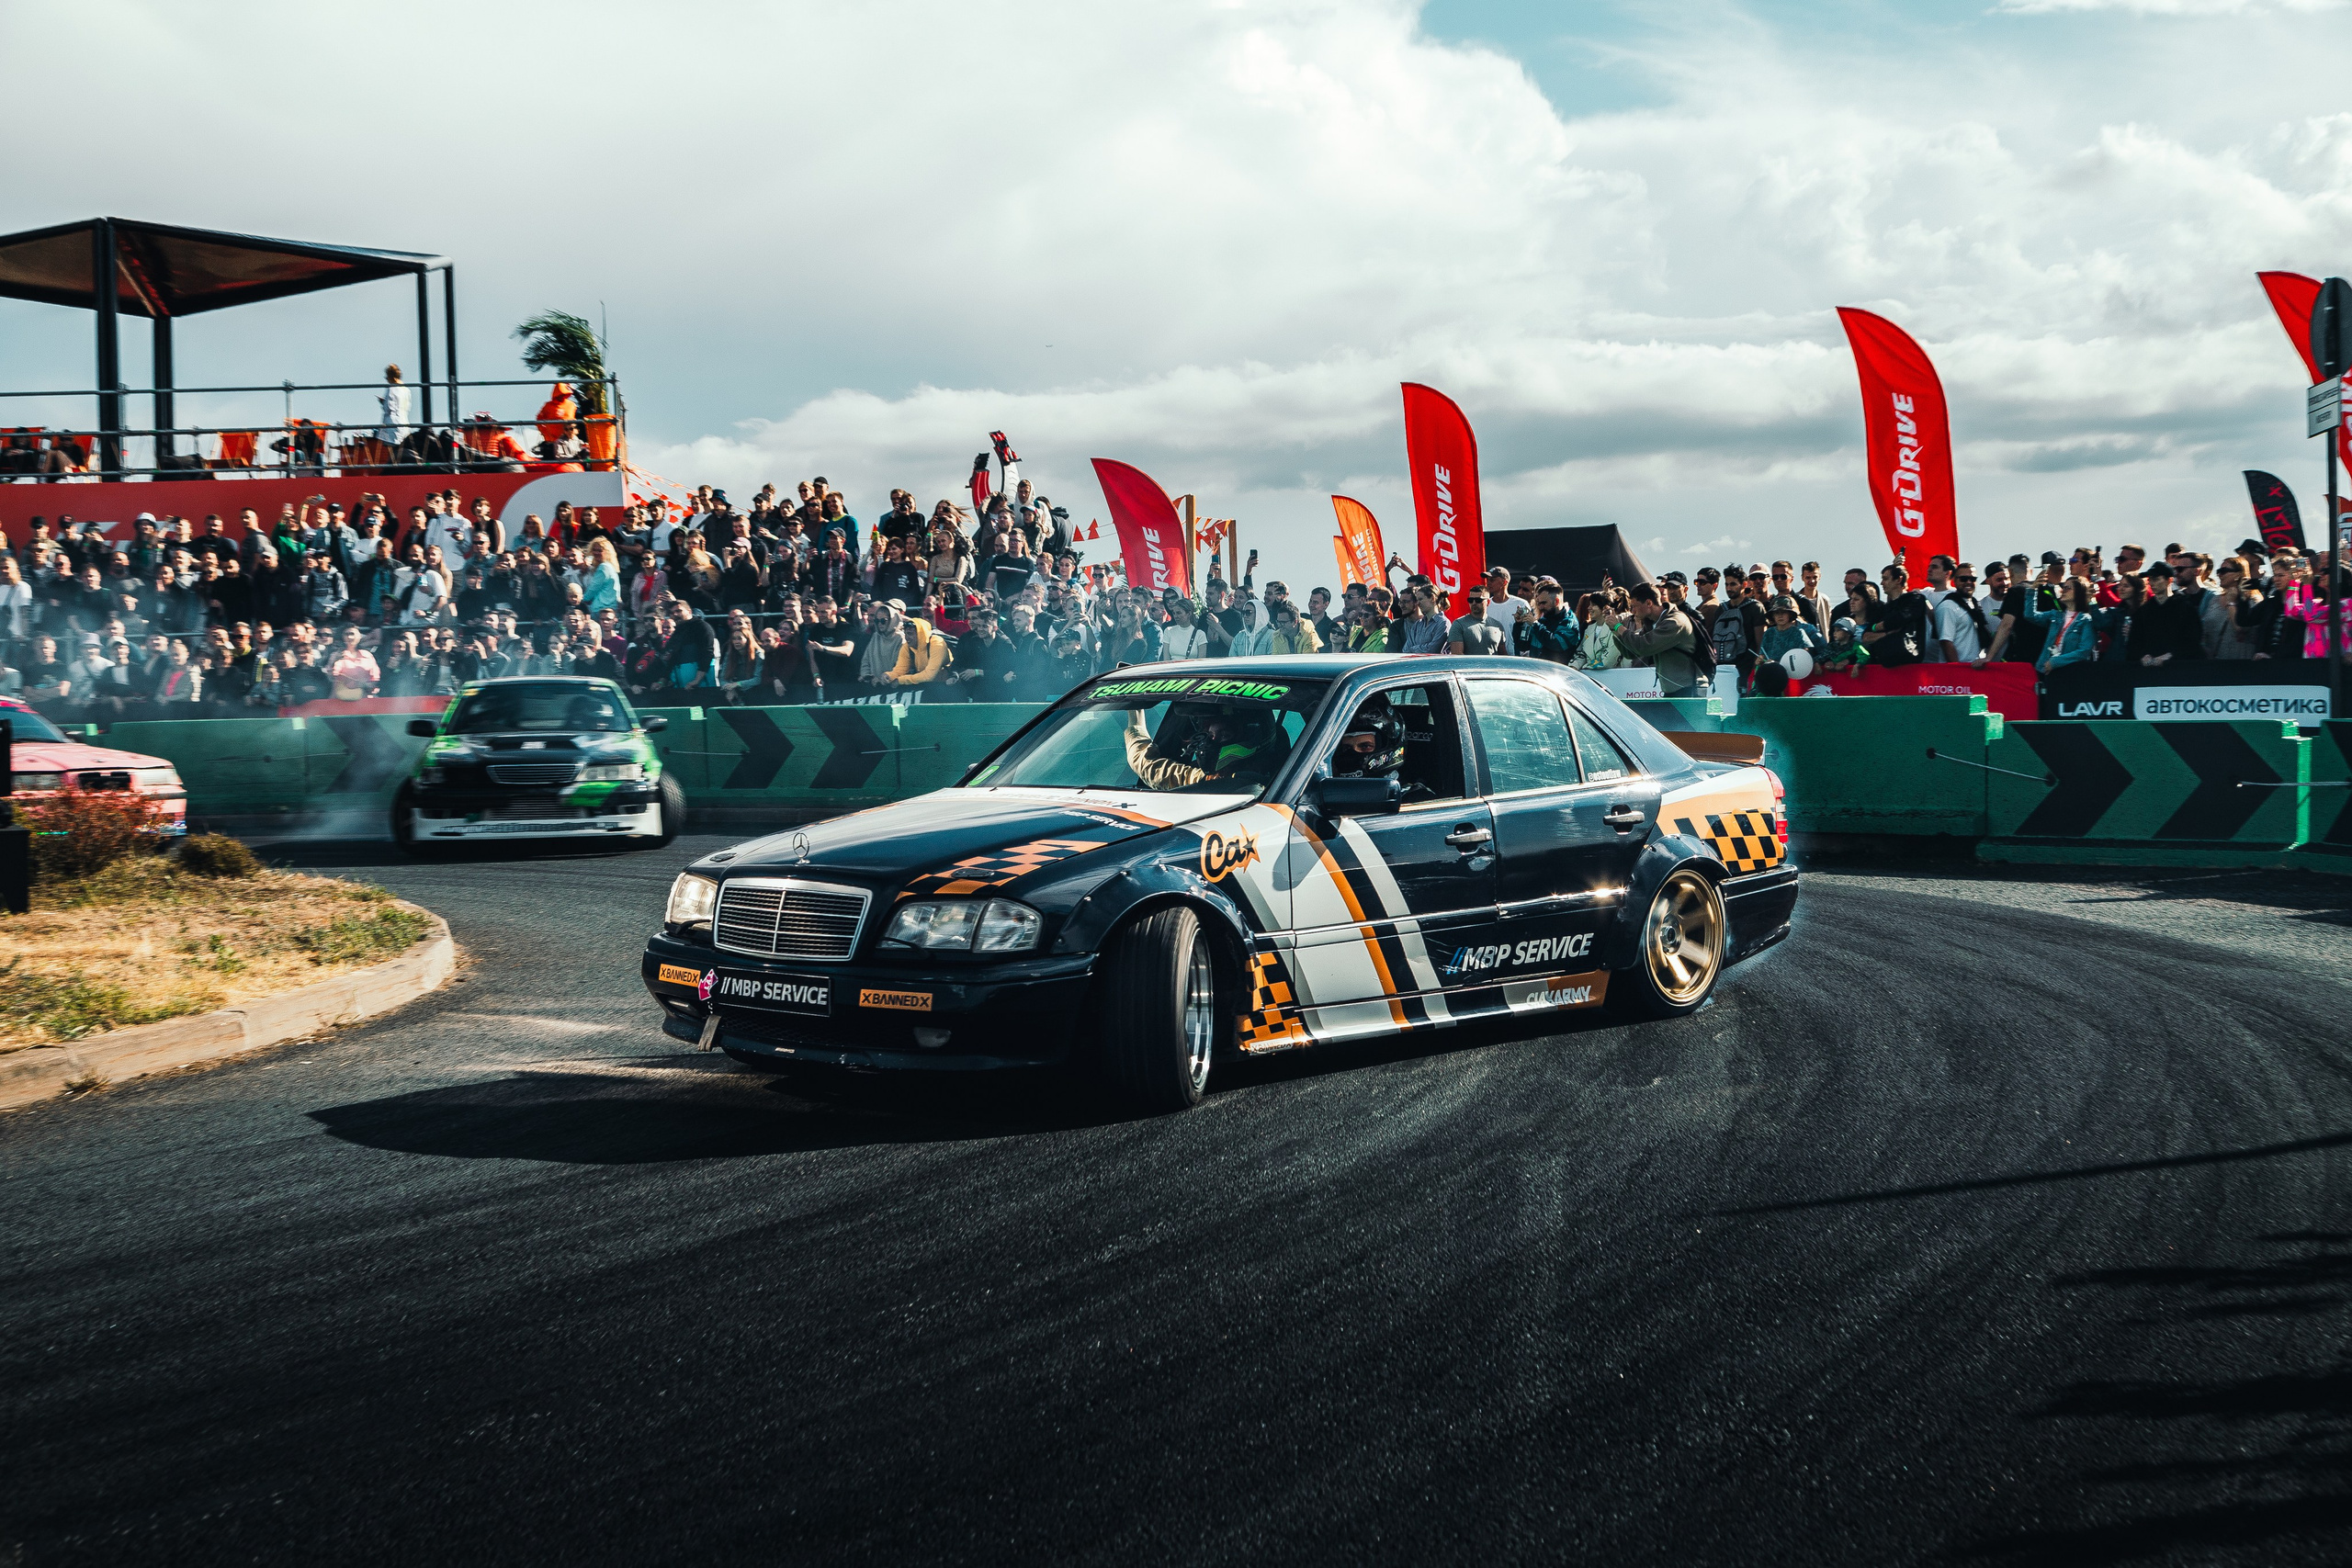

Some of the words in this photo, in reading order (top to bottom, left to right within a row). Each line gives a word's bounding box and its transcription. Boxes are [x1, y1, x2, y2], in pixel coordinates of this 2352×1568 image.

[1087, 679, 1198, 700] TSUNAMI
[1193, 679, 1291, 700] PICNIC
[1918, 685, 1954, 694] MOTOR
[1955, 686, 1973, 694] OIL
[2058, 701, 2123, 716] LAVR
[2145, 698, 2328, 715] автокосметика
[1511, 932, 1595, 965] SERVICE
[763, 983, 829, 1006] SERVICE
